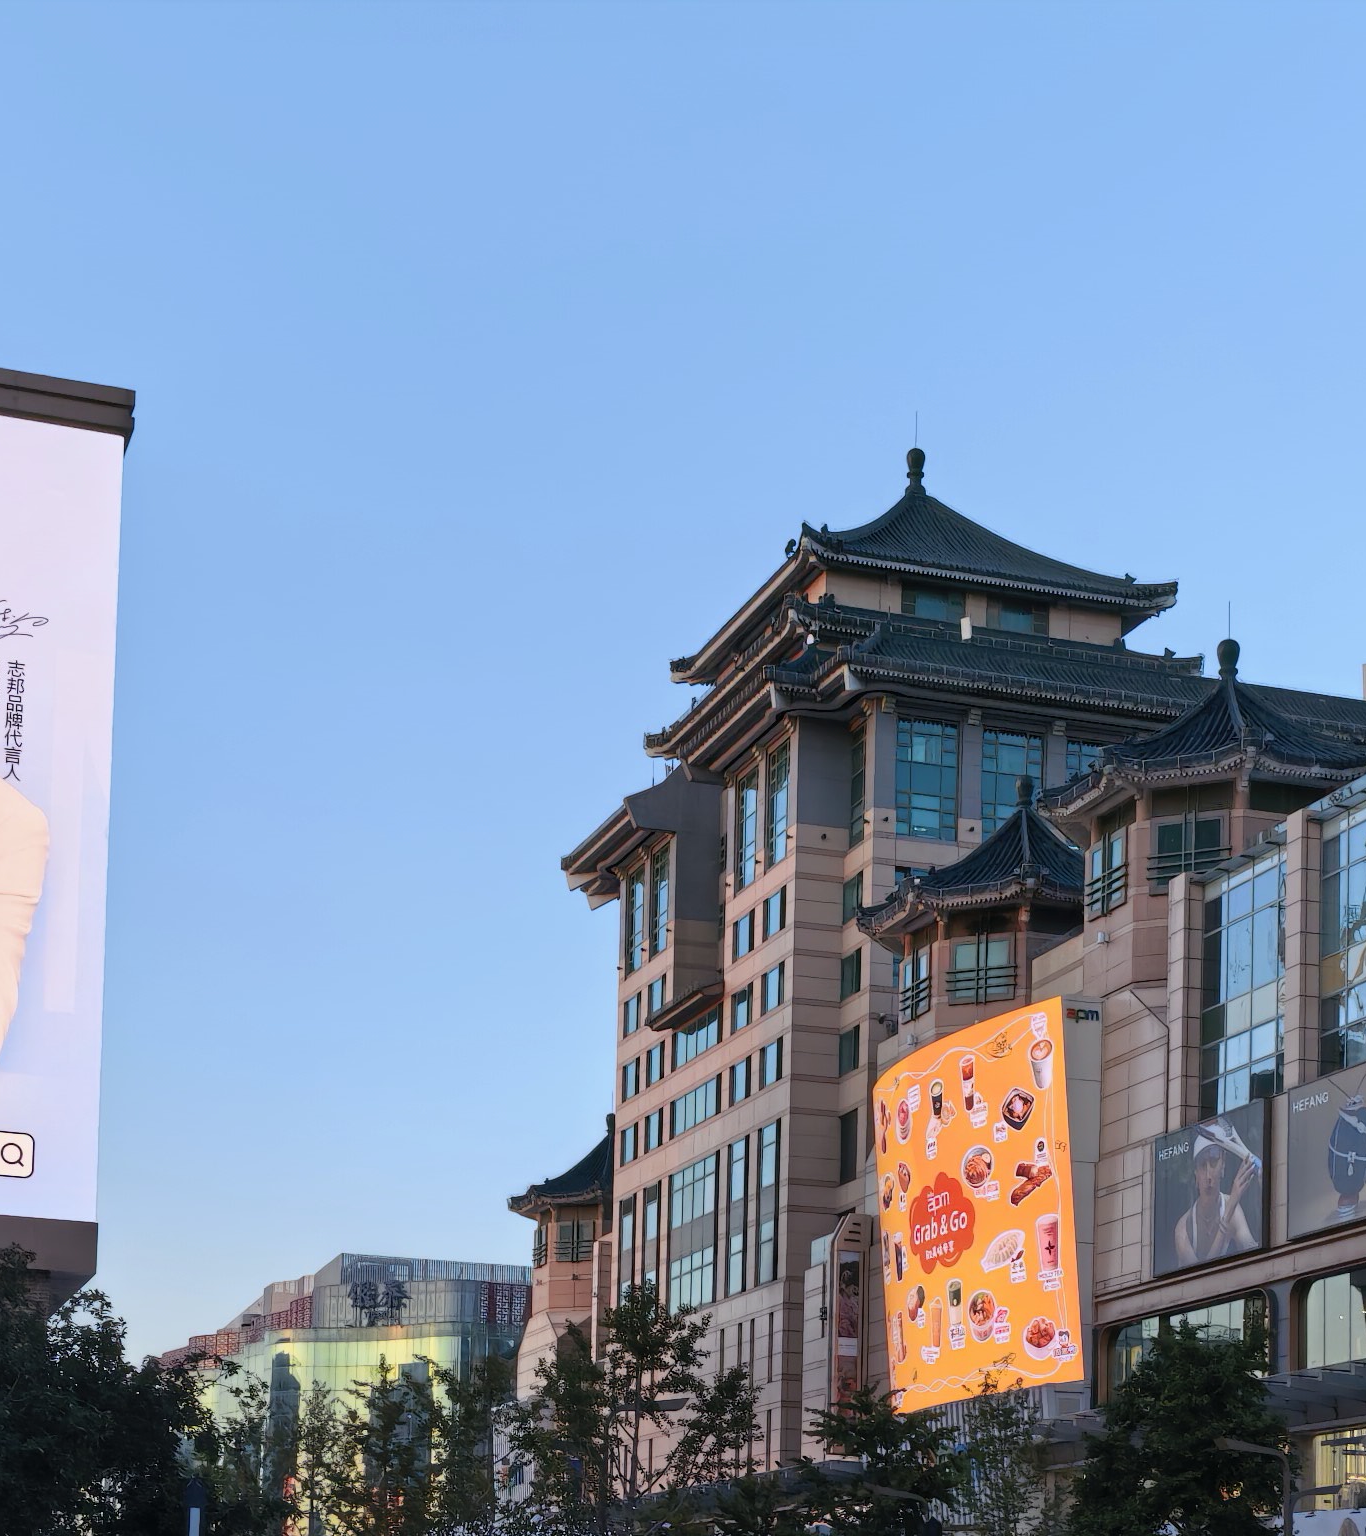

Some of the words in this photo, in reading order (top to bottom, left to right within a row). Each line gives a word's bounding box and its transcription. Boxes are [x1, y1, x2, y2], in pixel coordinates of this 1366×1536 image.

[3, 659, 27, 783] 志邦品牌代言人
[1066, 1008, 1099, 1023] apm
[1291, 1091, 1329, 1113] HEFANG
[1158, 1141, 1190, 1161] HEFANG
[914, 1216, 938, 1245] Grab
[949, 1210, 968, 1232] Go
